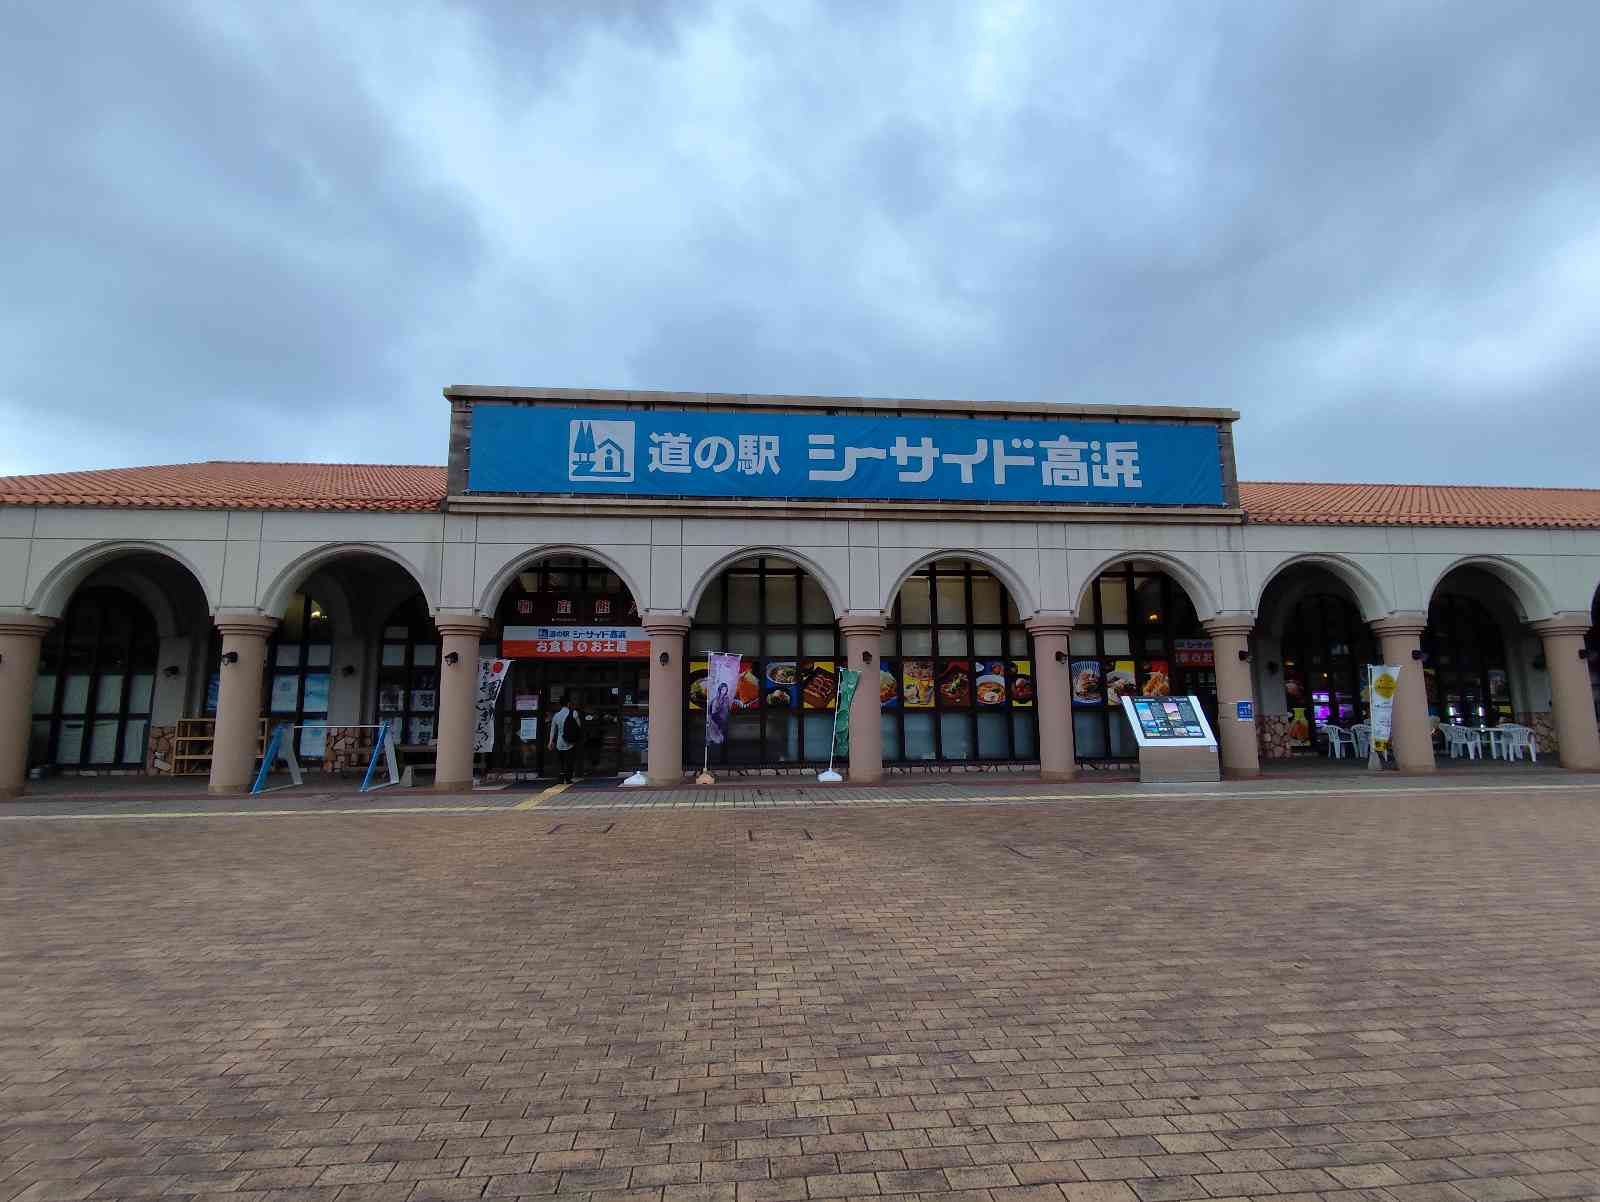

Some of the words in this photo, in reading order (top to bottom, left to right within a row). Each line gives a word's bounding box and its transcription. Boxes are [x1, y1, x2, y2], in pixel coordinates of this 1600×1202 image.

[648, 432, 781, 475] 道の駅
[808, 434, 1143, 488] シーサイド高浜
